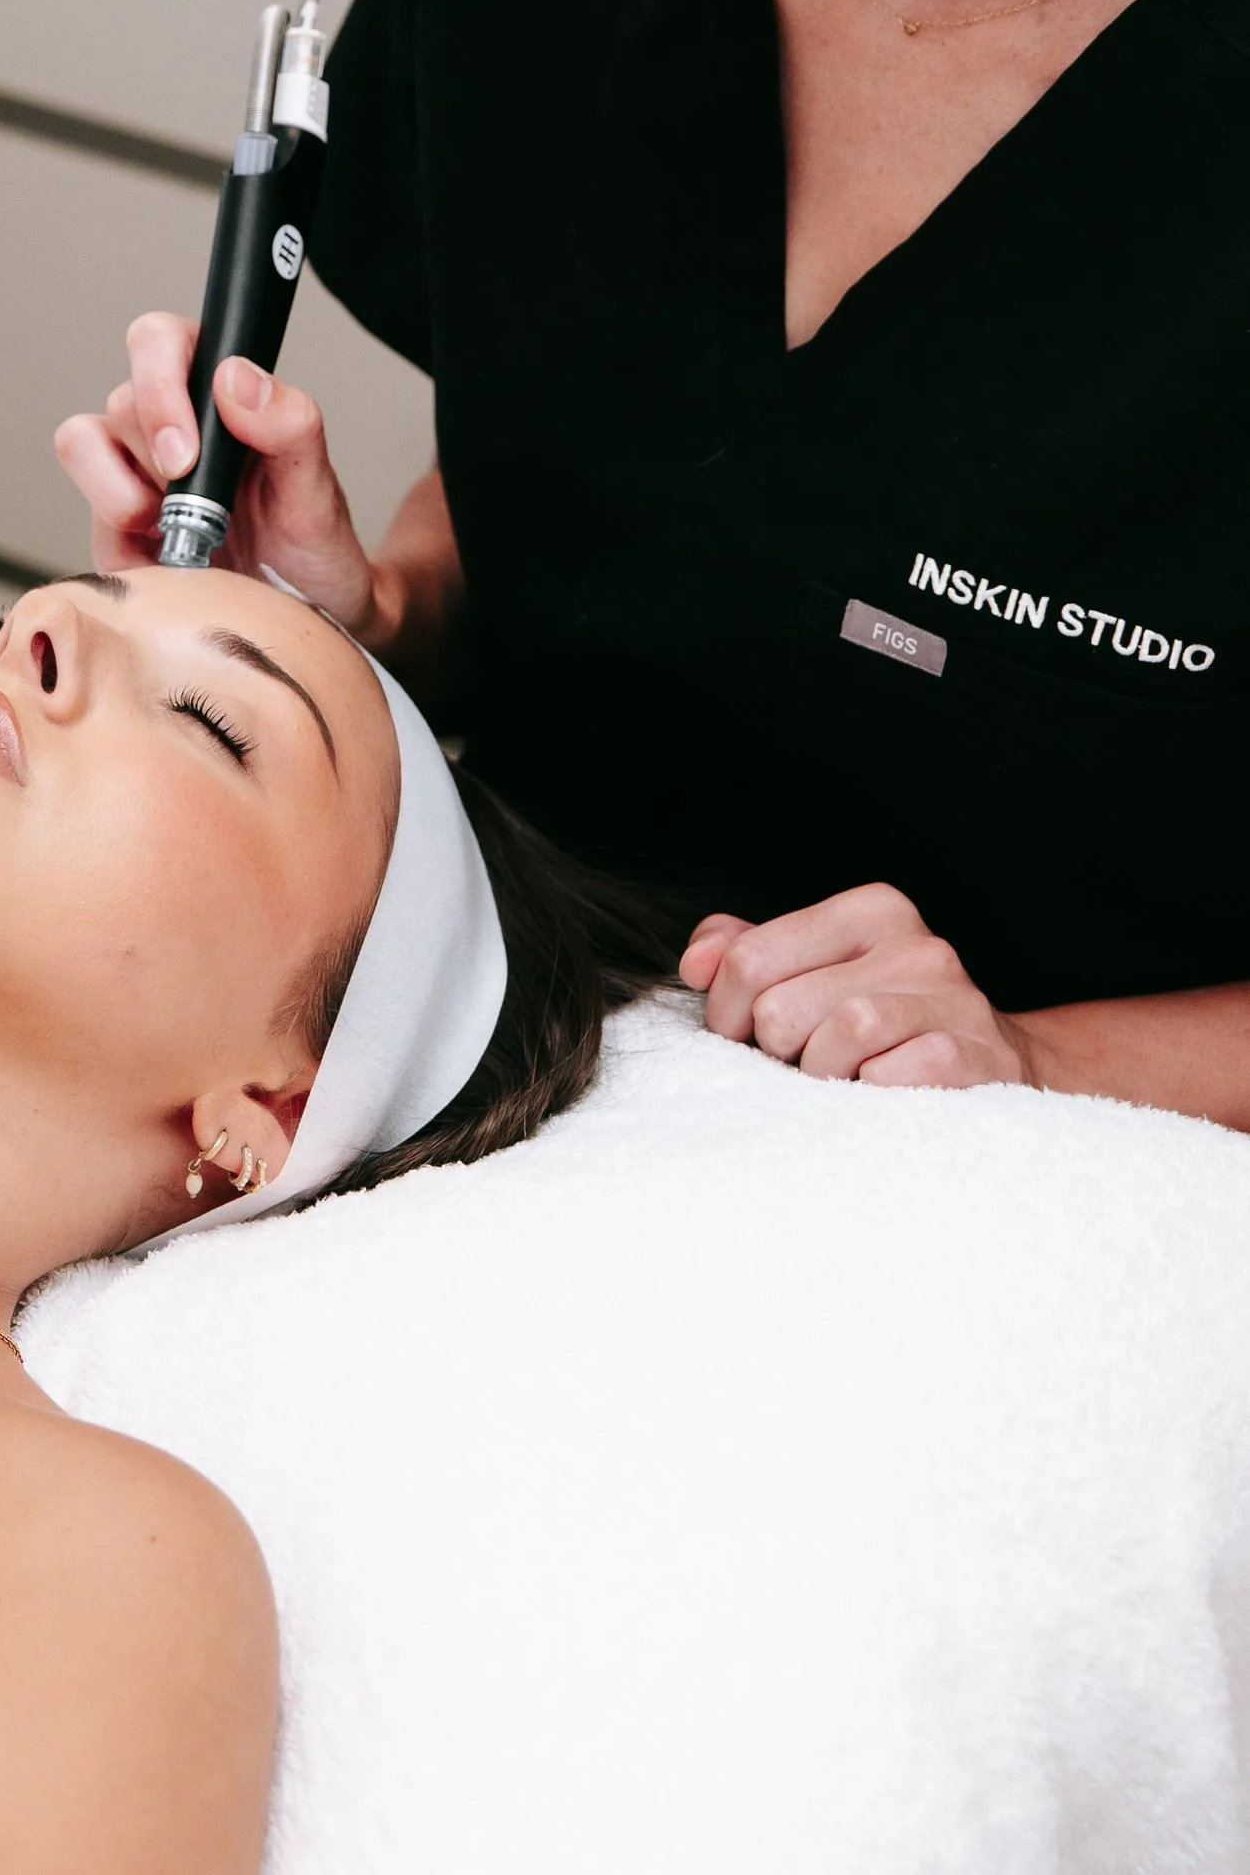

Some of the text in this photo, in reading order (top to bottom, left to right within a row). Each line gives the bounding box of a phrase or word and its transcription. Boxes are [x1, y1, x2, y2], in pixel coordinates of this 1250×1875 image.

[871, 622, 918, 656] FIGS
[908, 552, 1216, 672] INSKIN STUDIO
